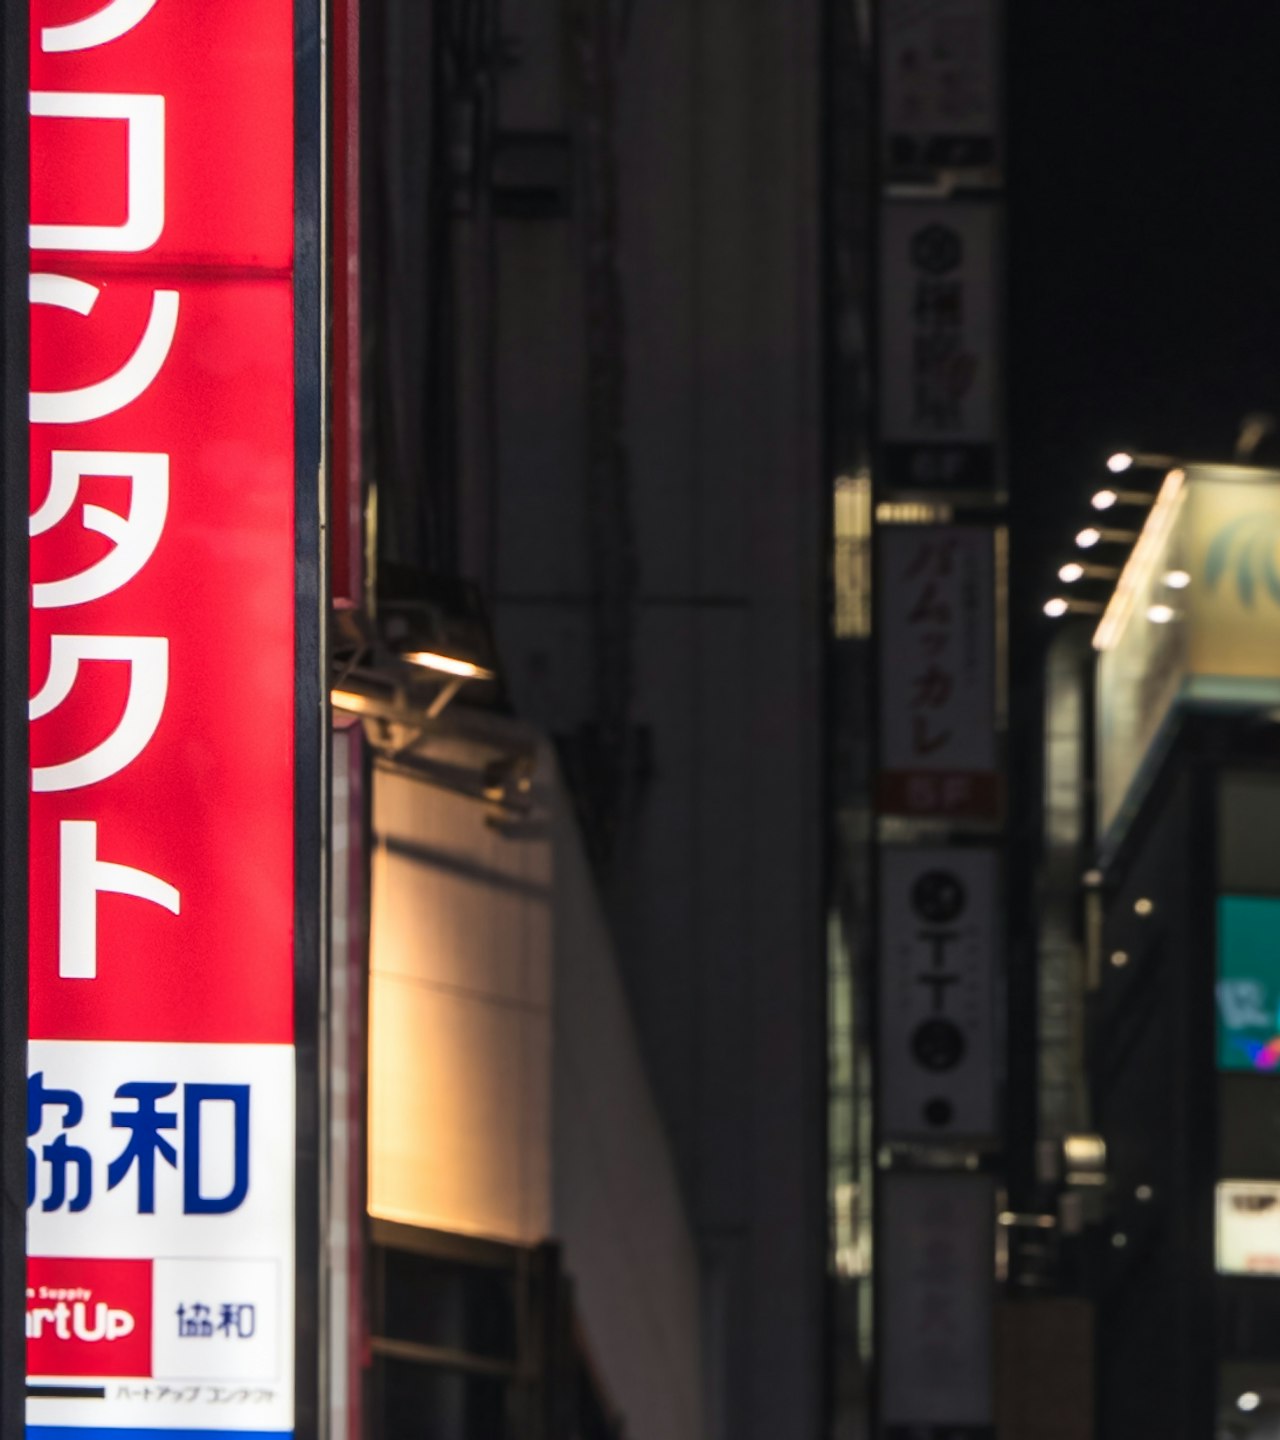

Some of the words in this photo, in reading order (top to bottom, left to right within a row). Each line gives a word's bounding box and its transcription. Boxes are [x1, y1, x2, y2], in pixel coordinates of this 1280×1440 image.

[28, 0, 181, 979] コンタクト
[38, 1286, 93, 1302] Supply
[175, 1301, 257, 1340] 協和
